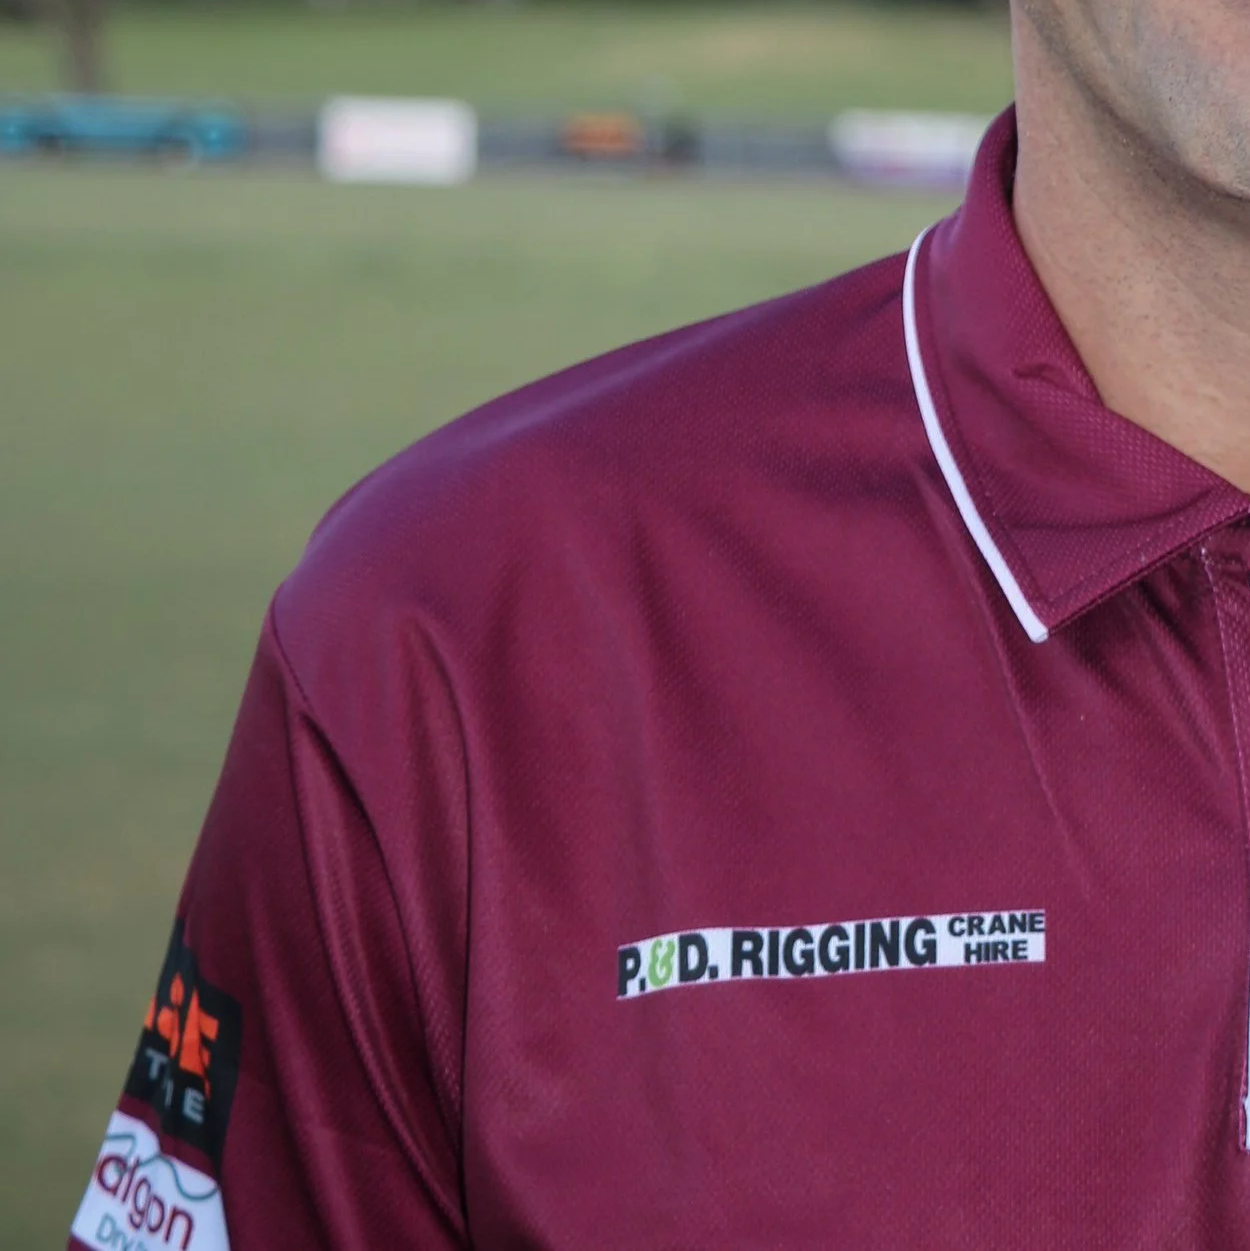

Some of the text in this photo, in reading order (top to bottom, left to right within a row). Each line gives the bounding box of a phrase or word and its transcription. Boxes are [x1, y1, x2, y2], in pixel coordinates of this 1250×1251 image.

[948, 912, 1045, 937] CRANE
[731, 918, 937, 977] RIGGING
[964, 940, 1029, 963] HIRE
